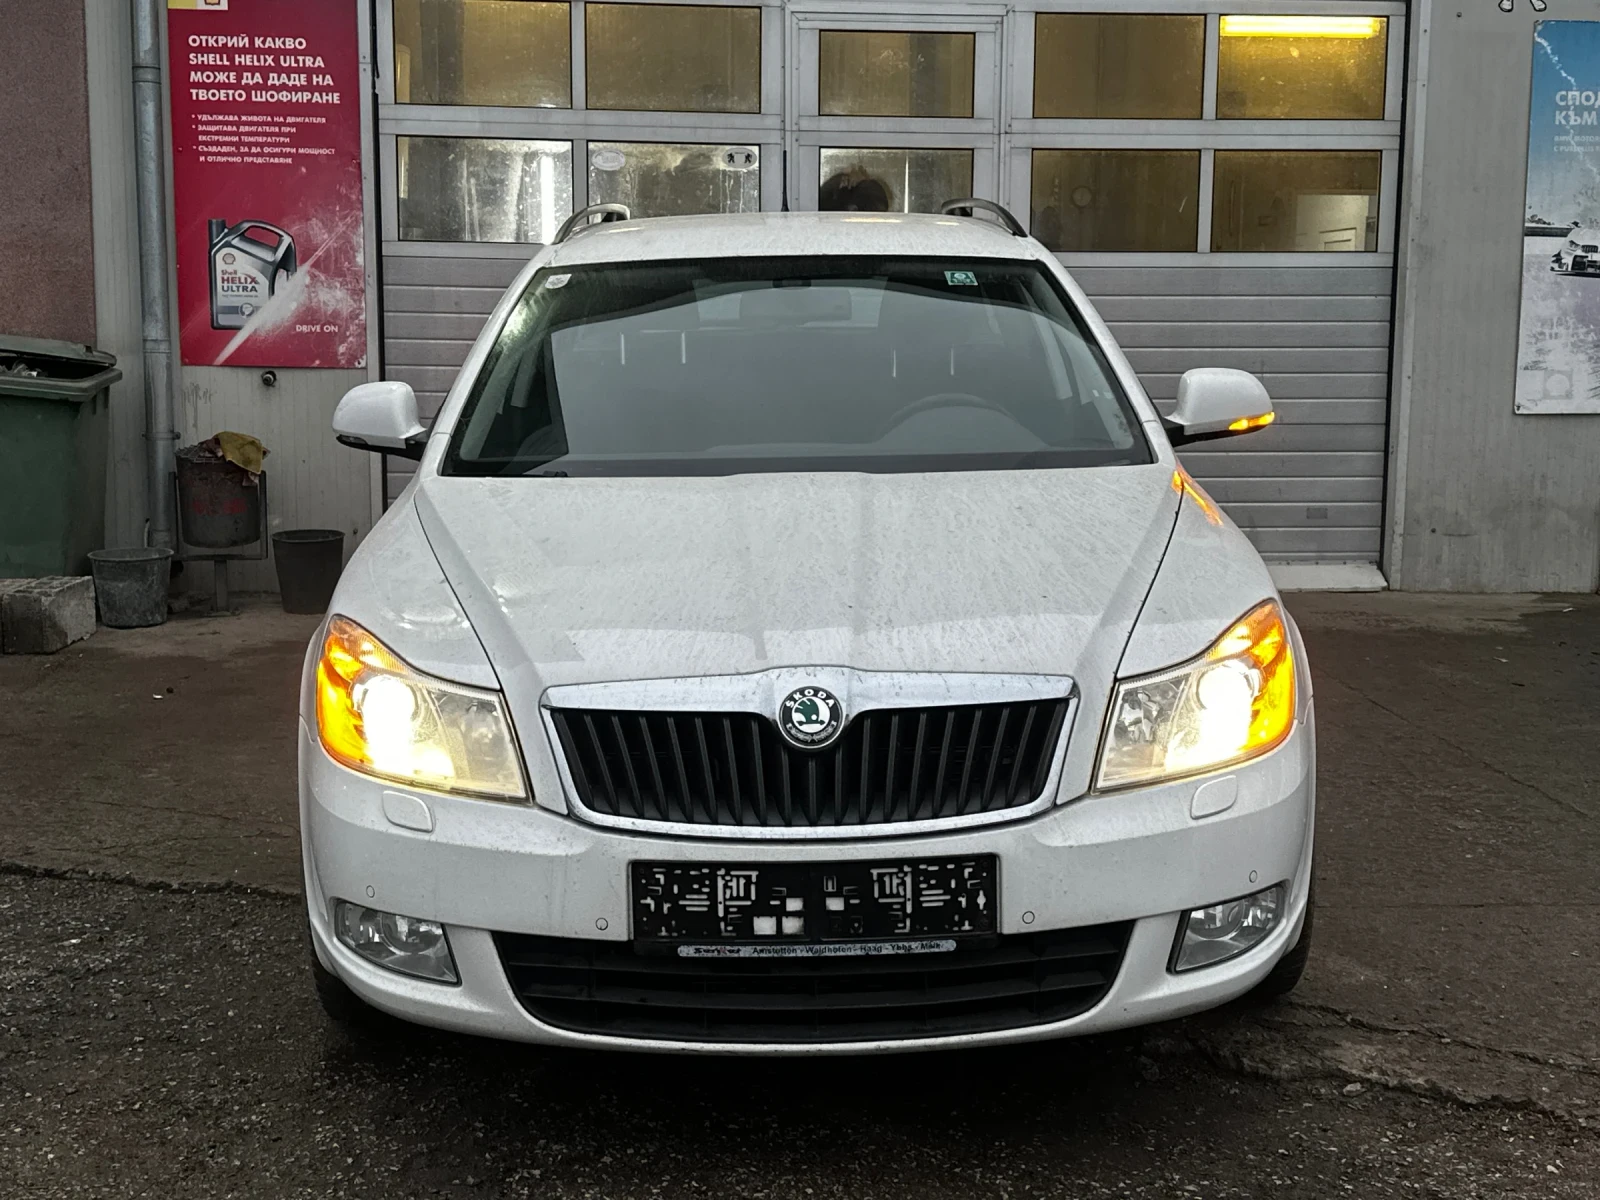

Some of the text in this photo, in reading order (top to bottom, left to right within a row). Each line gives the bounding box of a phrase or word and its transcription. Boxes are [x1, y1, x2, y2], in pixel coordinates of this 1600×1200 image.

[188, 34, 307, 50] ОТКРИЙ КАКВО
[189, 52, 325, 68] SHELL HELIX ULTRA
[189, 70, 334, 87] МОЖЕ ДА ДАДЕ НА
[189, 88, 341, 104] ТВОЕТО ШОФИРАНЕ
[240, 115, 272, 123] ЖИВОТА
[286, 116, 326, 124] ДВИГАТЕЛЯ
[1555, 110, 1598, 126] КЪМ
[197, 124, 238, 132] ЗАЩИТАВА
[238, 125, 280, 133] ДВИГАТЕЛЯ
[240, 135, 290, 143] ТЕМПЕРАТУРИ
[239, 145, 250, 153] ЗА
[298, 147, 335, 155] МОЩНОСТ
[243, 156, 293, 164] ПРЕДСТАВЯНЕ
[221, 275, 259, 285] HELIX
[221, 285, 258, 293] ULTRA
[296, 324, 338, 333] DRIVE ON
